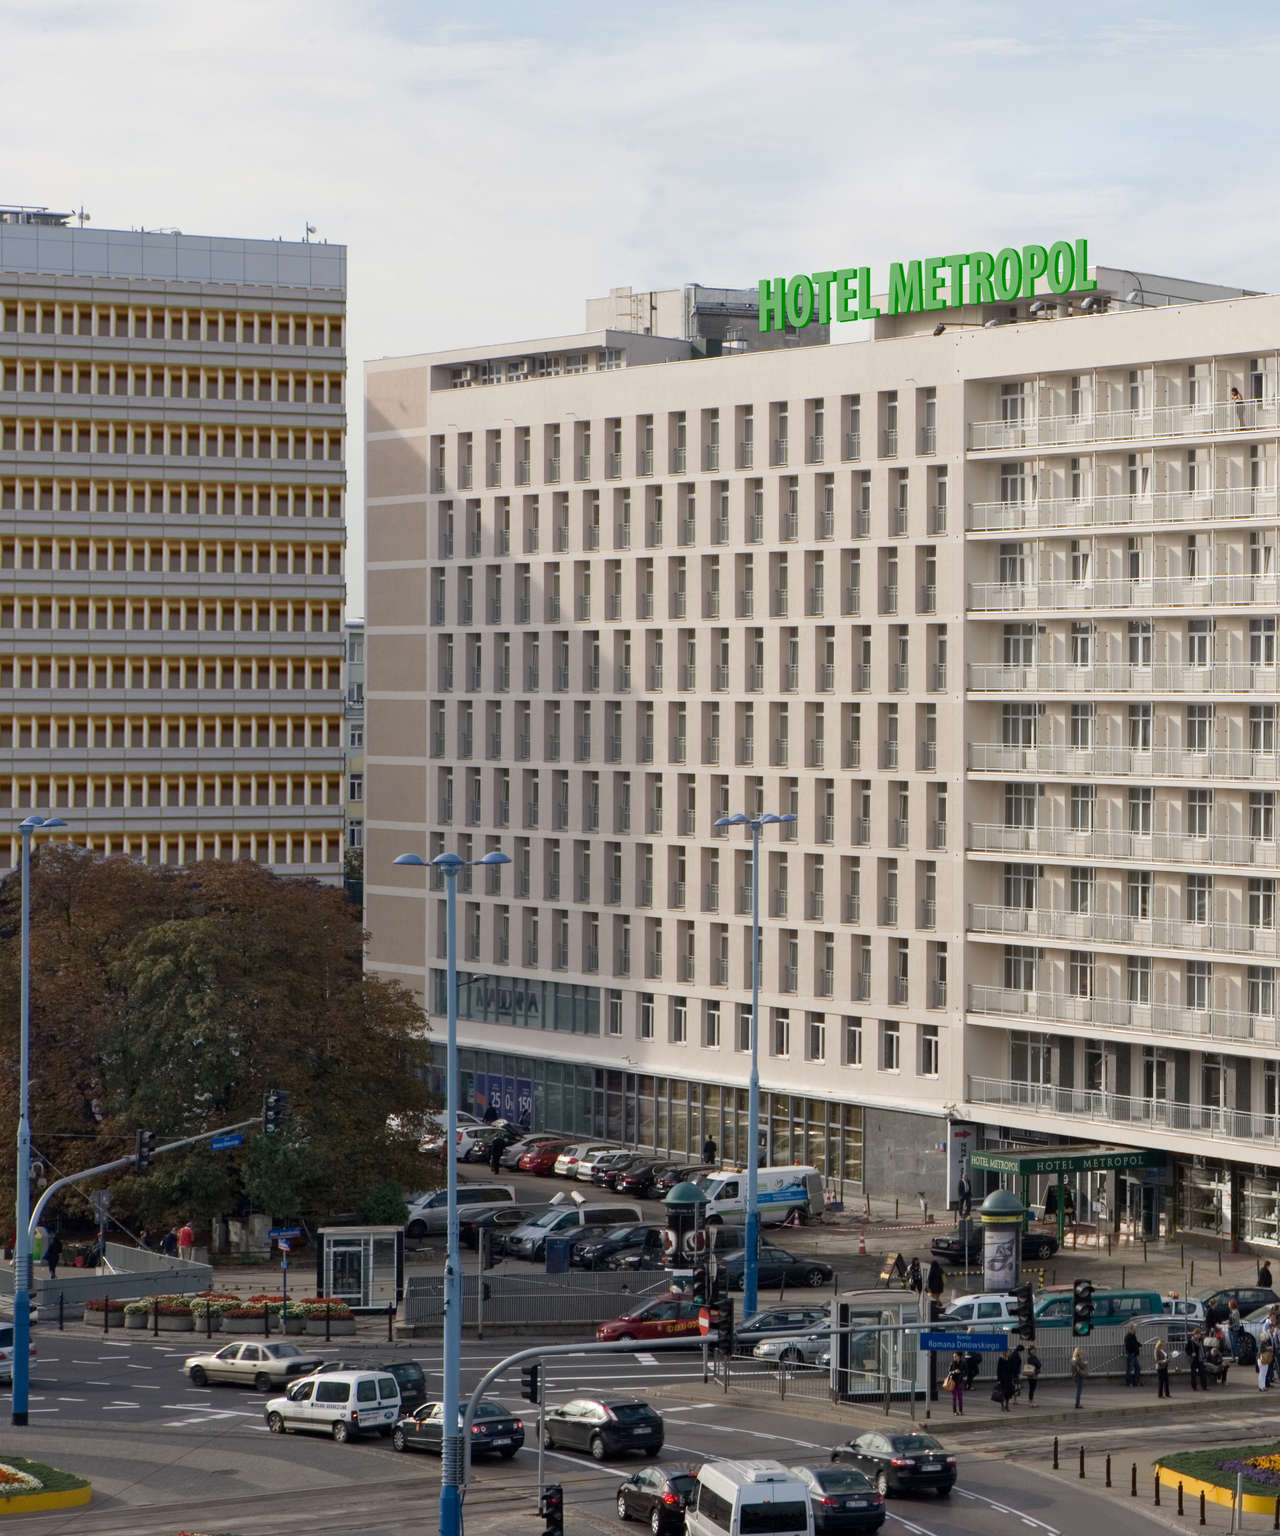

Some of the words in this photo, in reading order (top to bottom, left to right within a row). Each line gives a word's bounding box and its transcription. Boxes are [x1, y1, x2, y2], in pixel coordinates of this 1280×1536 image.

[758, 266, 880, 333] HOTEL
[887, 238, 1098, 316] METROPOL
[971, 1155, 989, 1169] HOTEL
[989, 1158, 1020, 1173] METROPOL
[1037, 1161, 1074, 1171] HOTEL
[1083, 1155, 1145, 1169] METROPOL
